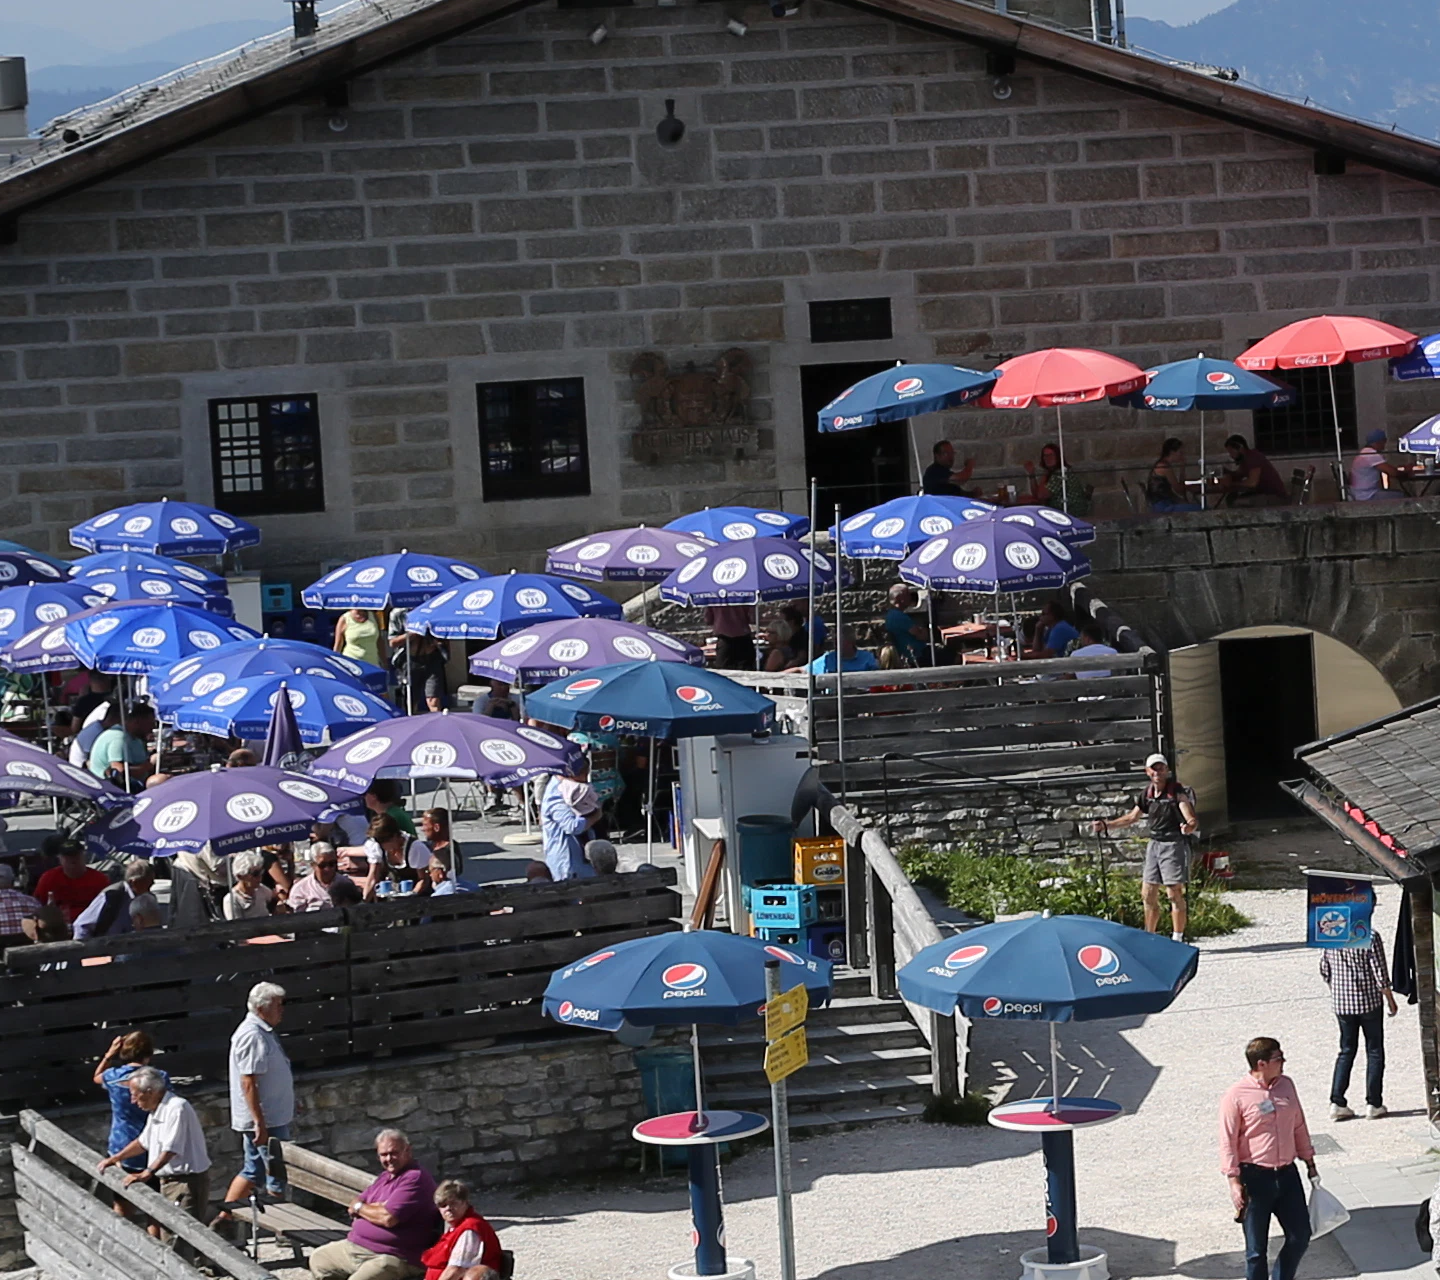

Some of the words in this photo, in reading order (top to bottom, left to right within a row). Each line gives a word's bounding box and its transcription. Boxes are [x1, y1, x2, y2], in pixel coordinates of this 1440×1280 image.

[1156, 397, 1178, 407] pepsi
[616, 720, 648, 732] pepsi
[424, 749, 443, 765] HB
[242, 806, 263, 818] HB
[164, 816, 182, 826] HB
[218, 832, 254, 848] HOFBRÄU
[265, 823, 307, 837] MÜNCHEN
[1095, 974, 1131, 988] pepsi
[663, 989, 707, 1000] pepsi
[572, 1007, 600, 1021] pepsi
[1004, 1002, 1042, 1014] pepsi
